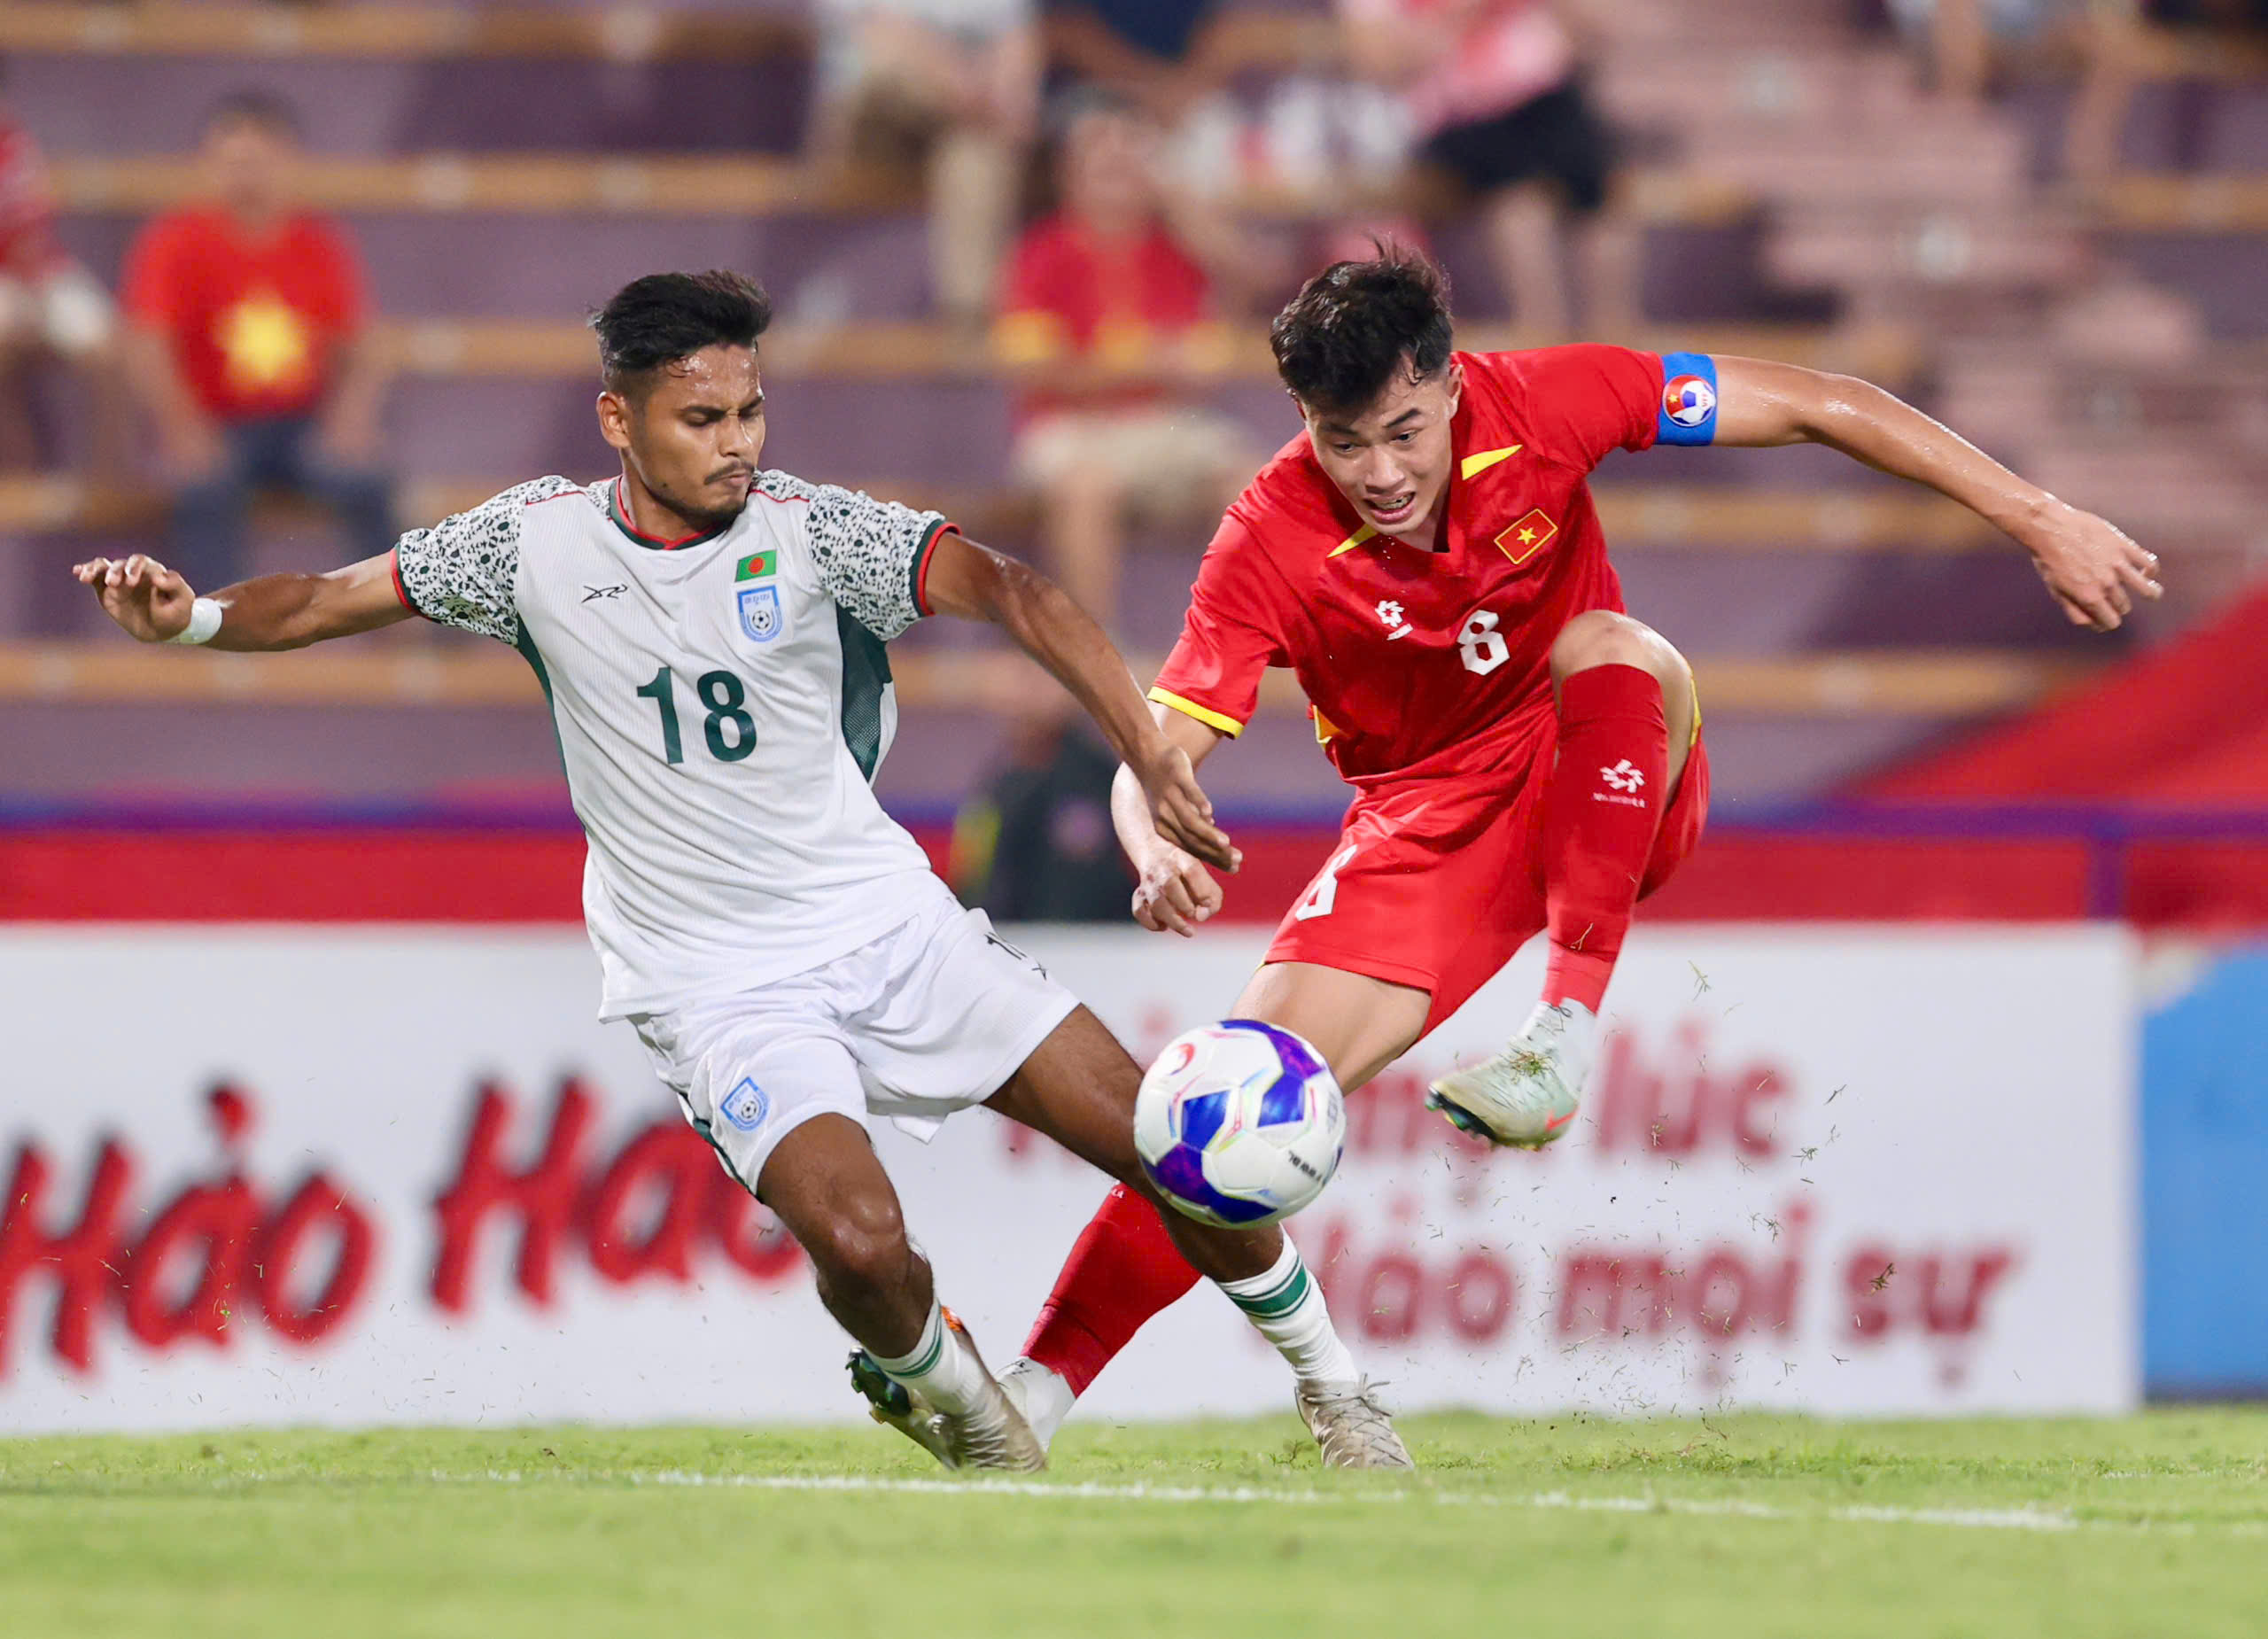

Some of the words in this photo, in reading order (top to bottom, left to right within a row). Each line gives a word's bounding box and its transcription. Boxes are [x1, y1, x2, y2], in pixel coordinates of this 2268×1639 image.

[1458, 610, 1510, 675] 8
[636, 666, 757, 764] 18
[1295, 844, 1358, 921] 8
